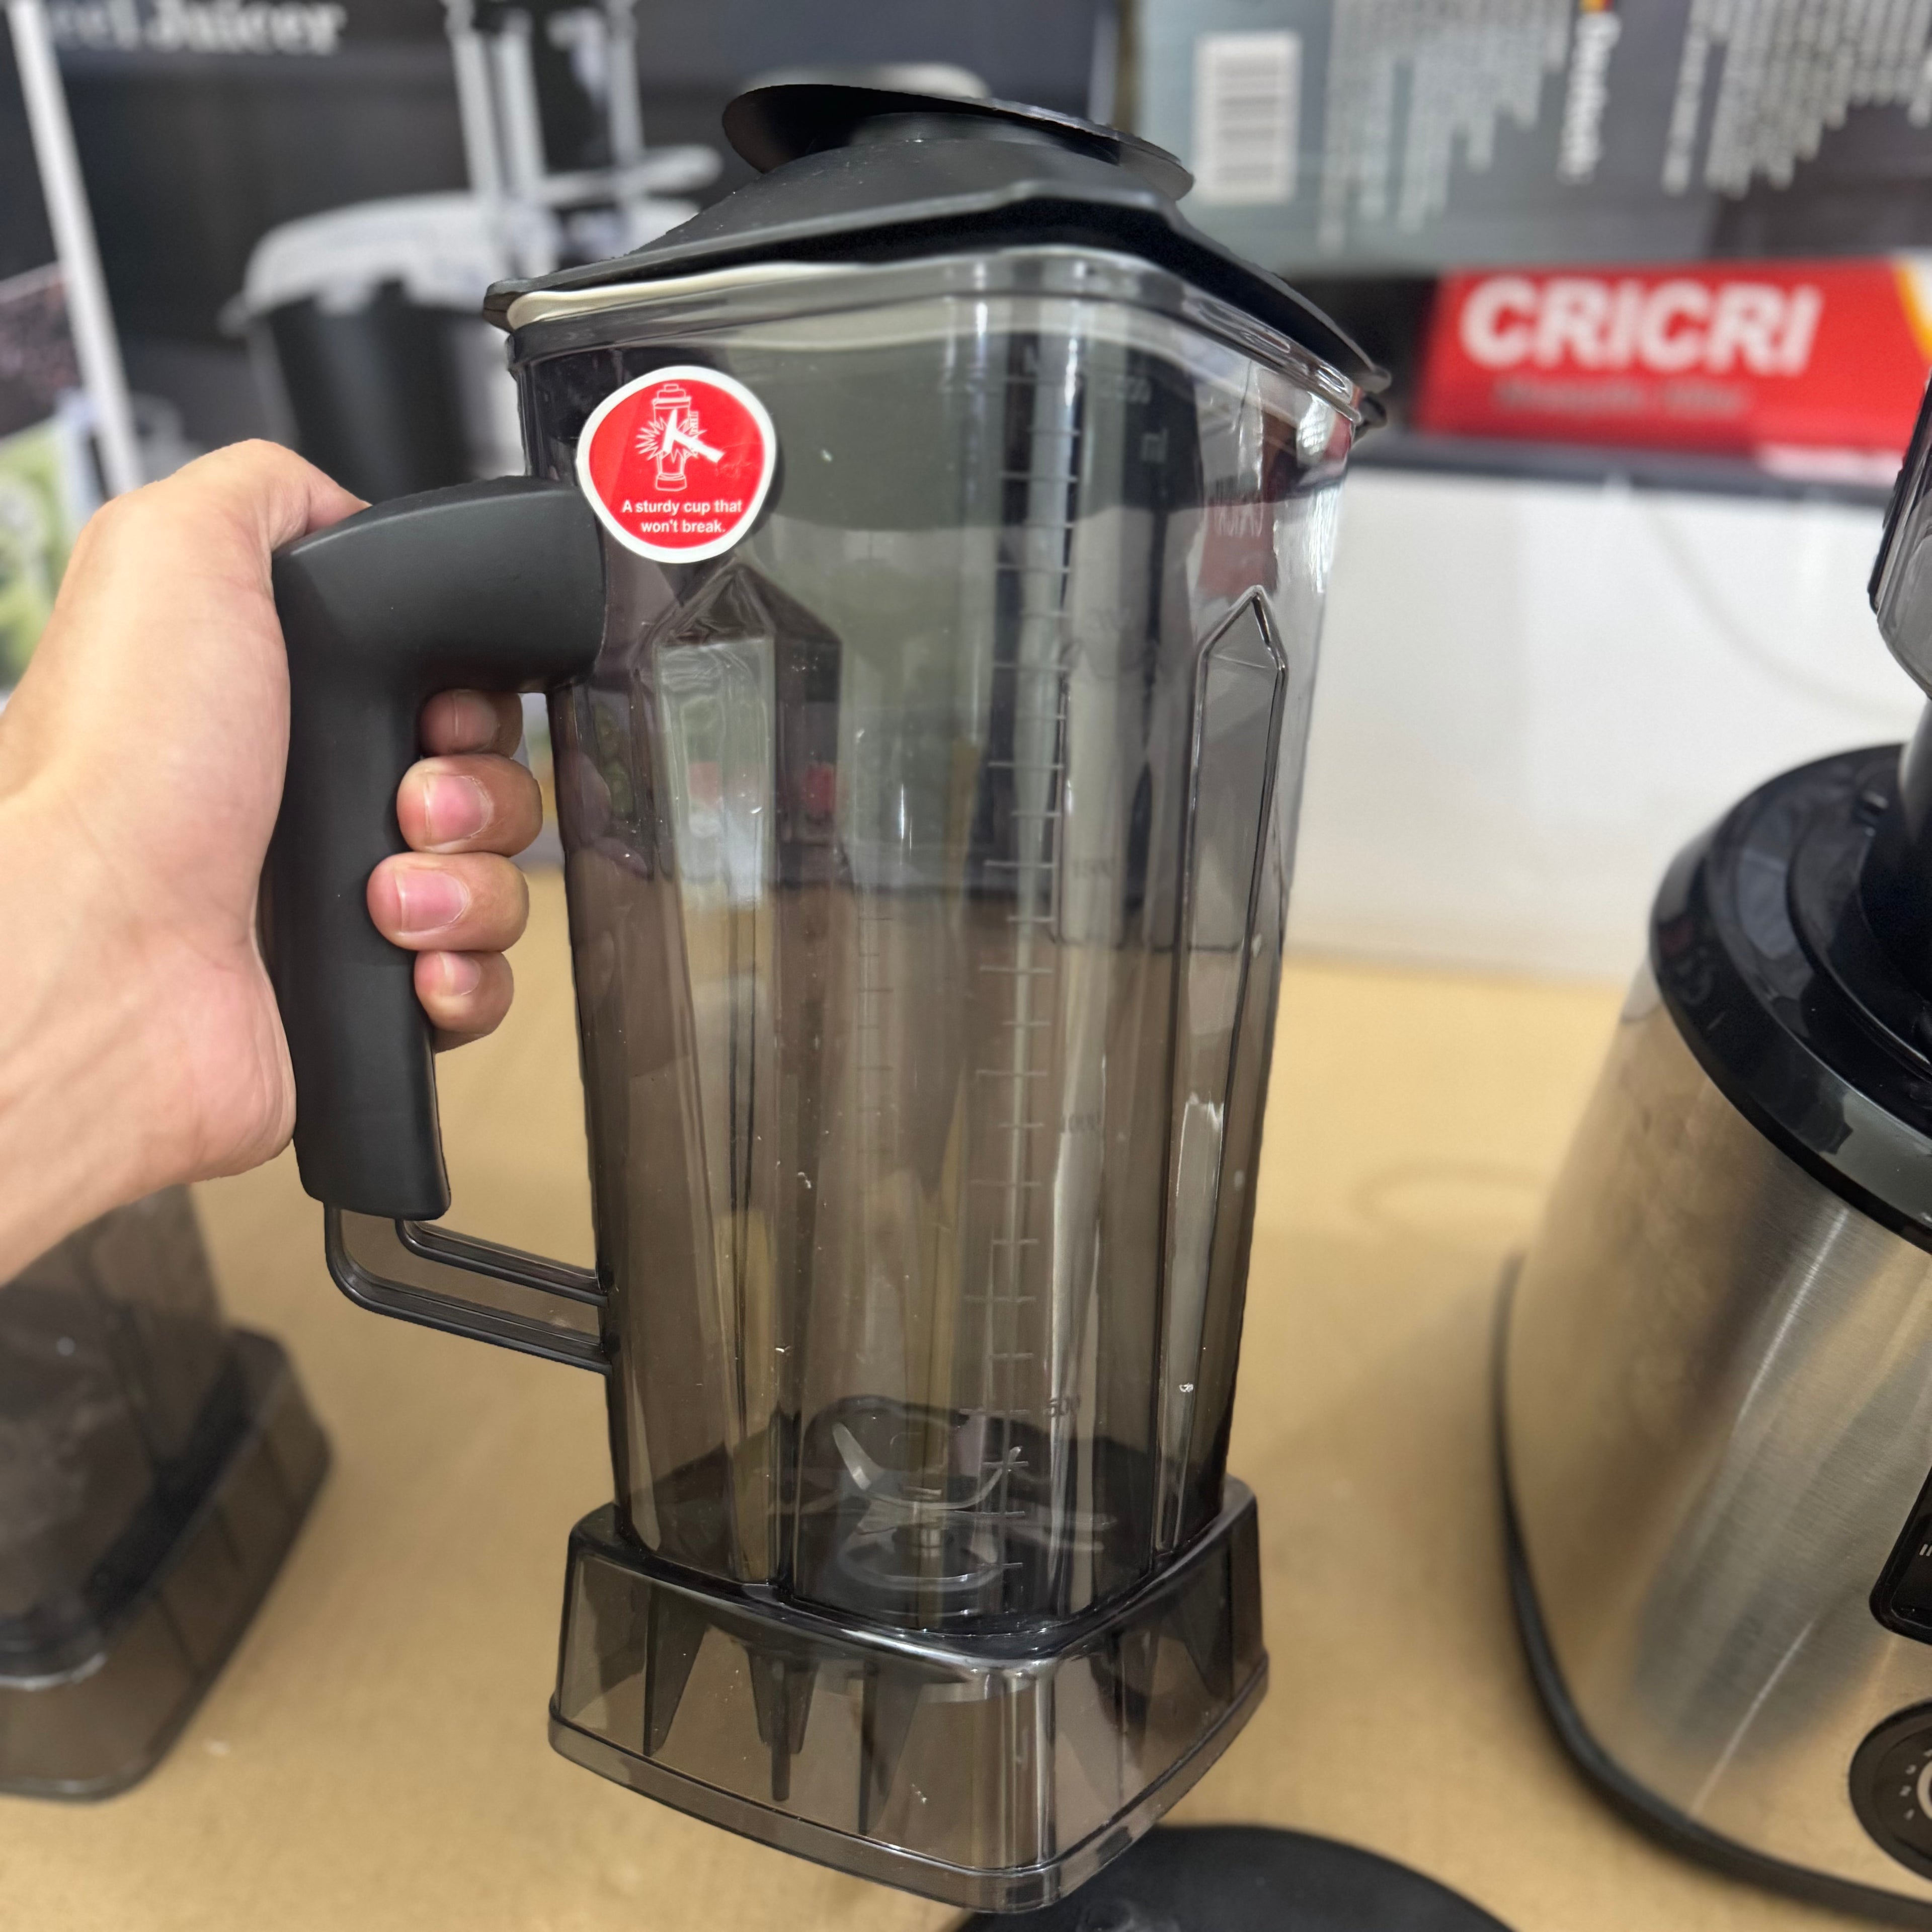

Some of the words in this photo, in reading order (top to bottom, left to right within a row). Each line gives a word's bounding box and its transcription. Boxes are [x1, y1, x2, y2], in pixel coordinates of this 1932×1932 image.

[1459, 275, 1823, 376] CRICRI
[622, 500, 632, 513] A
[635, 500, 680, 516] sturdy
[683, 502, 710, 516] cup
[714, 499, 742, 513] that
[641, 519, 678, 532] won't
[682, 519, 726, 532] break.
